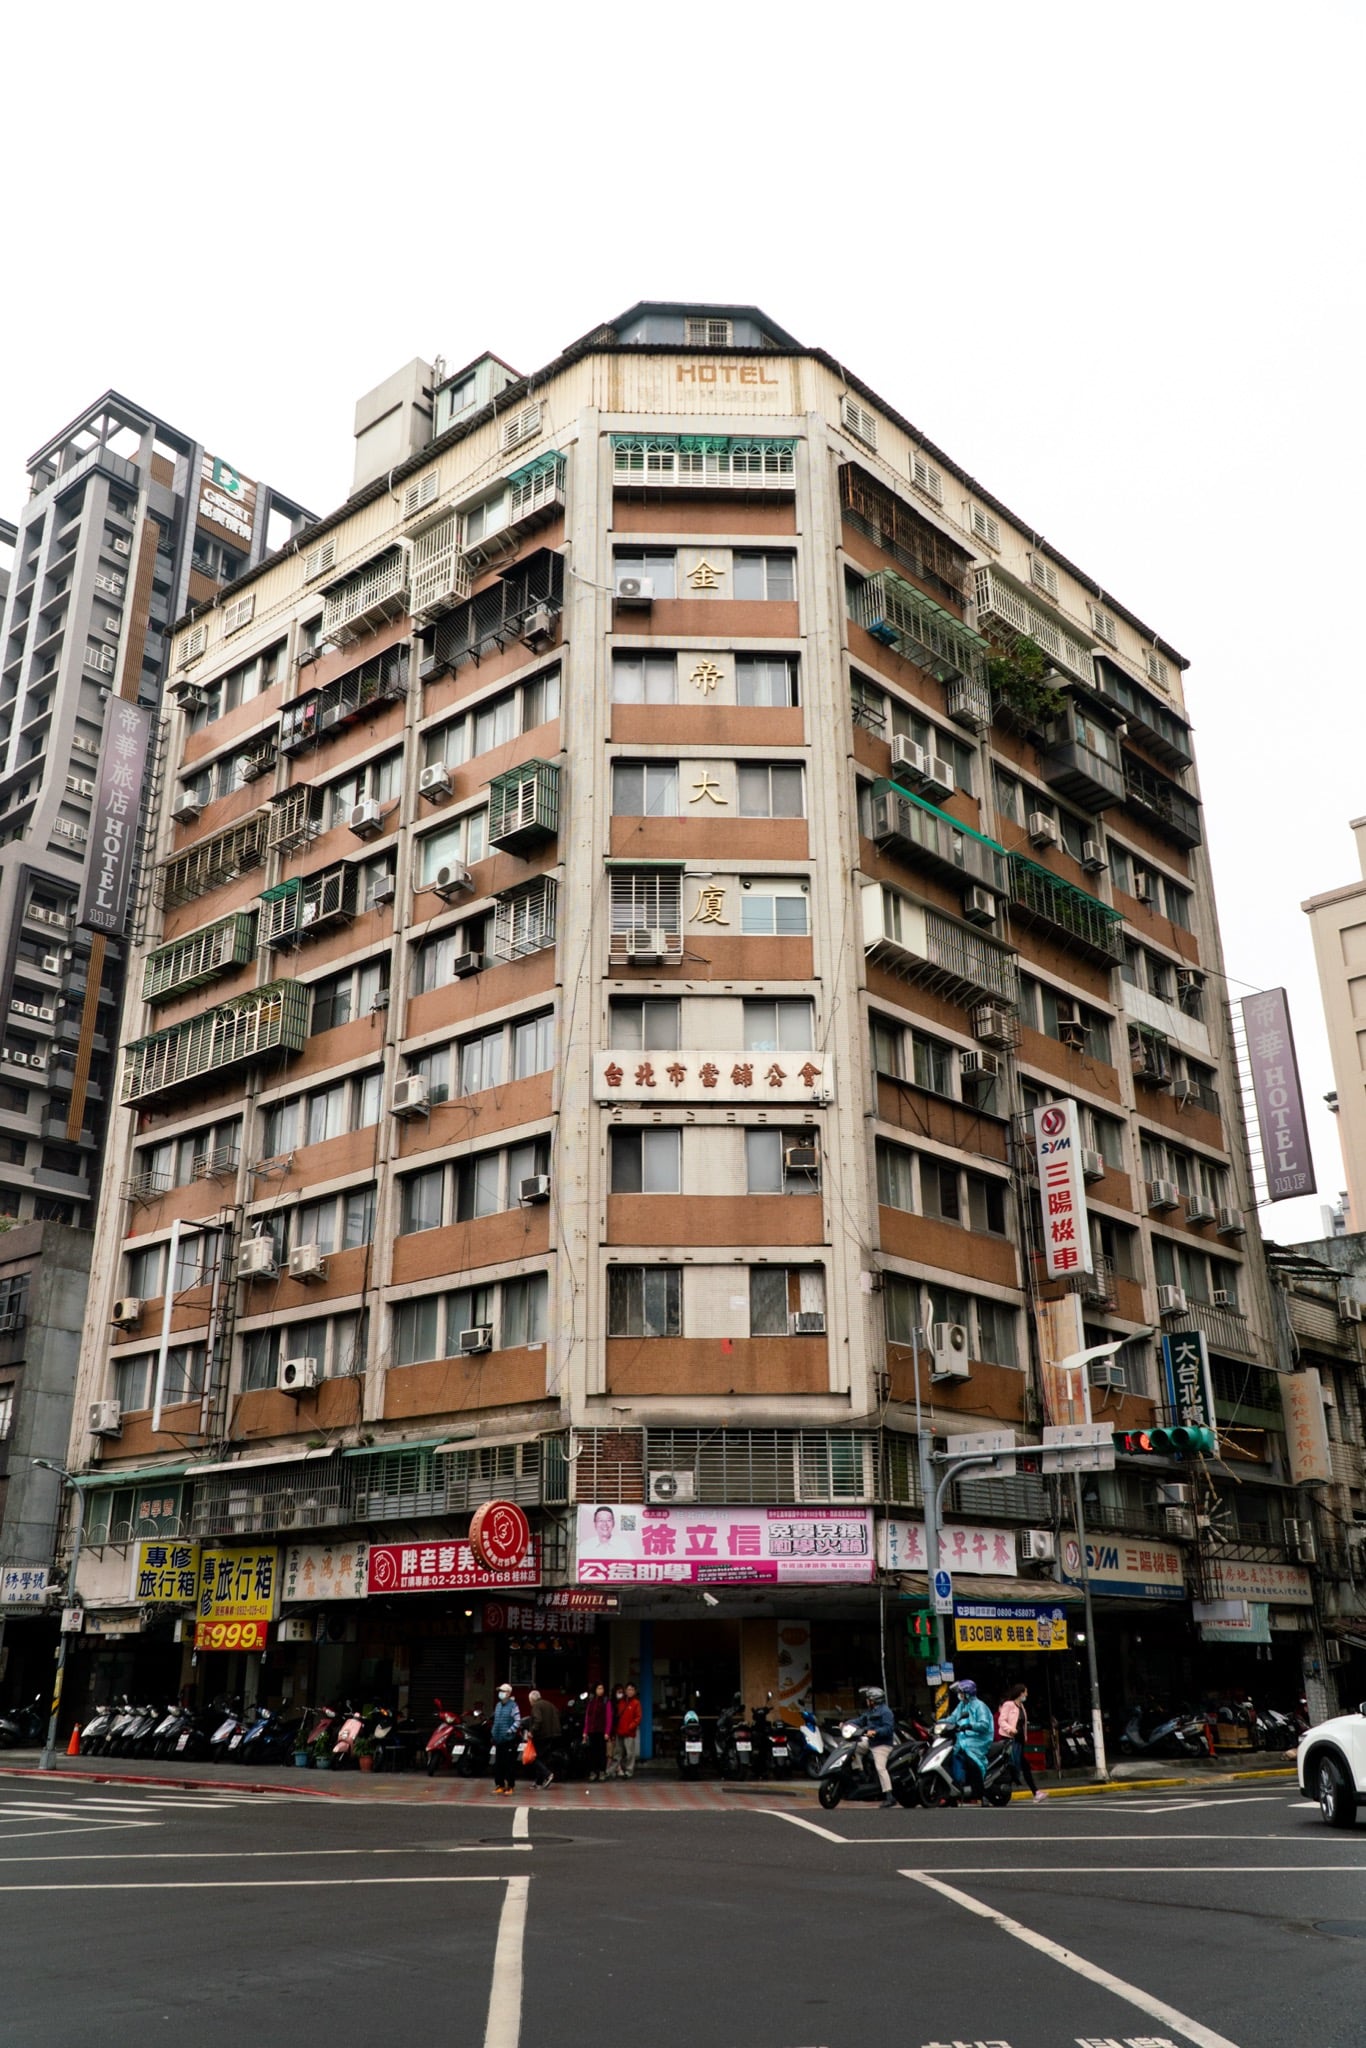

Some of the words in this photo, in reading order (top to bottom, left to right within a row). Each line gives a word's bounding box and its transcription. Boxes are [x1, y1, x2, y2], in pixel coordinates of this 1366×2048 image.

[676, 364, 779, 385] HOTEL
[687, 556, 731, 926] 金帝大廈
[105, 707, 142, 816] 帝華旅店
[95, 814, 123, 910] HOTEL
[1250, 996, 1285, 1064] 帝華
[1263, 1065, 1298, 1173] HOTEL
[1040, 1137, 1071, 1155] SYM
[1045, 1161, 1079, 1270] 三陽機車
[641, 1523, 761, 1556] 徐立信
[145, 1547, 192, 1569] 專修
[579, 1562, 692, 1581] 公益助學
[1085, 1545, 1119, 1571] SYM
[1125, 1548, 1179, 1575] 三陽機車
[138, 1570, 196, 1598] 旅行箱
[200, 1556, 217, 1617] 專修
[215, 1554, 275, 1601] 旅行箱
[512, 1570, 536, 1582] 桂林店
[570, 1594, 606, 1605] HOTEL
[1006, 1625, 1034, 1642] 免租金
